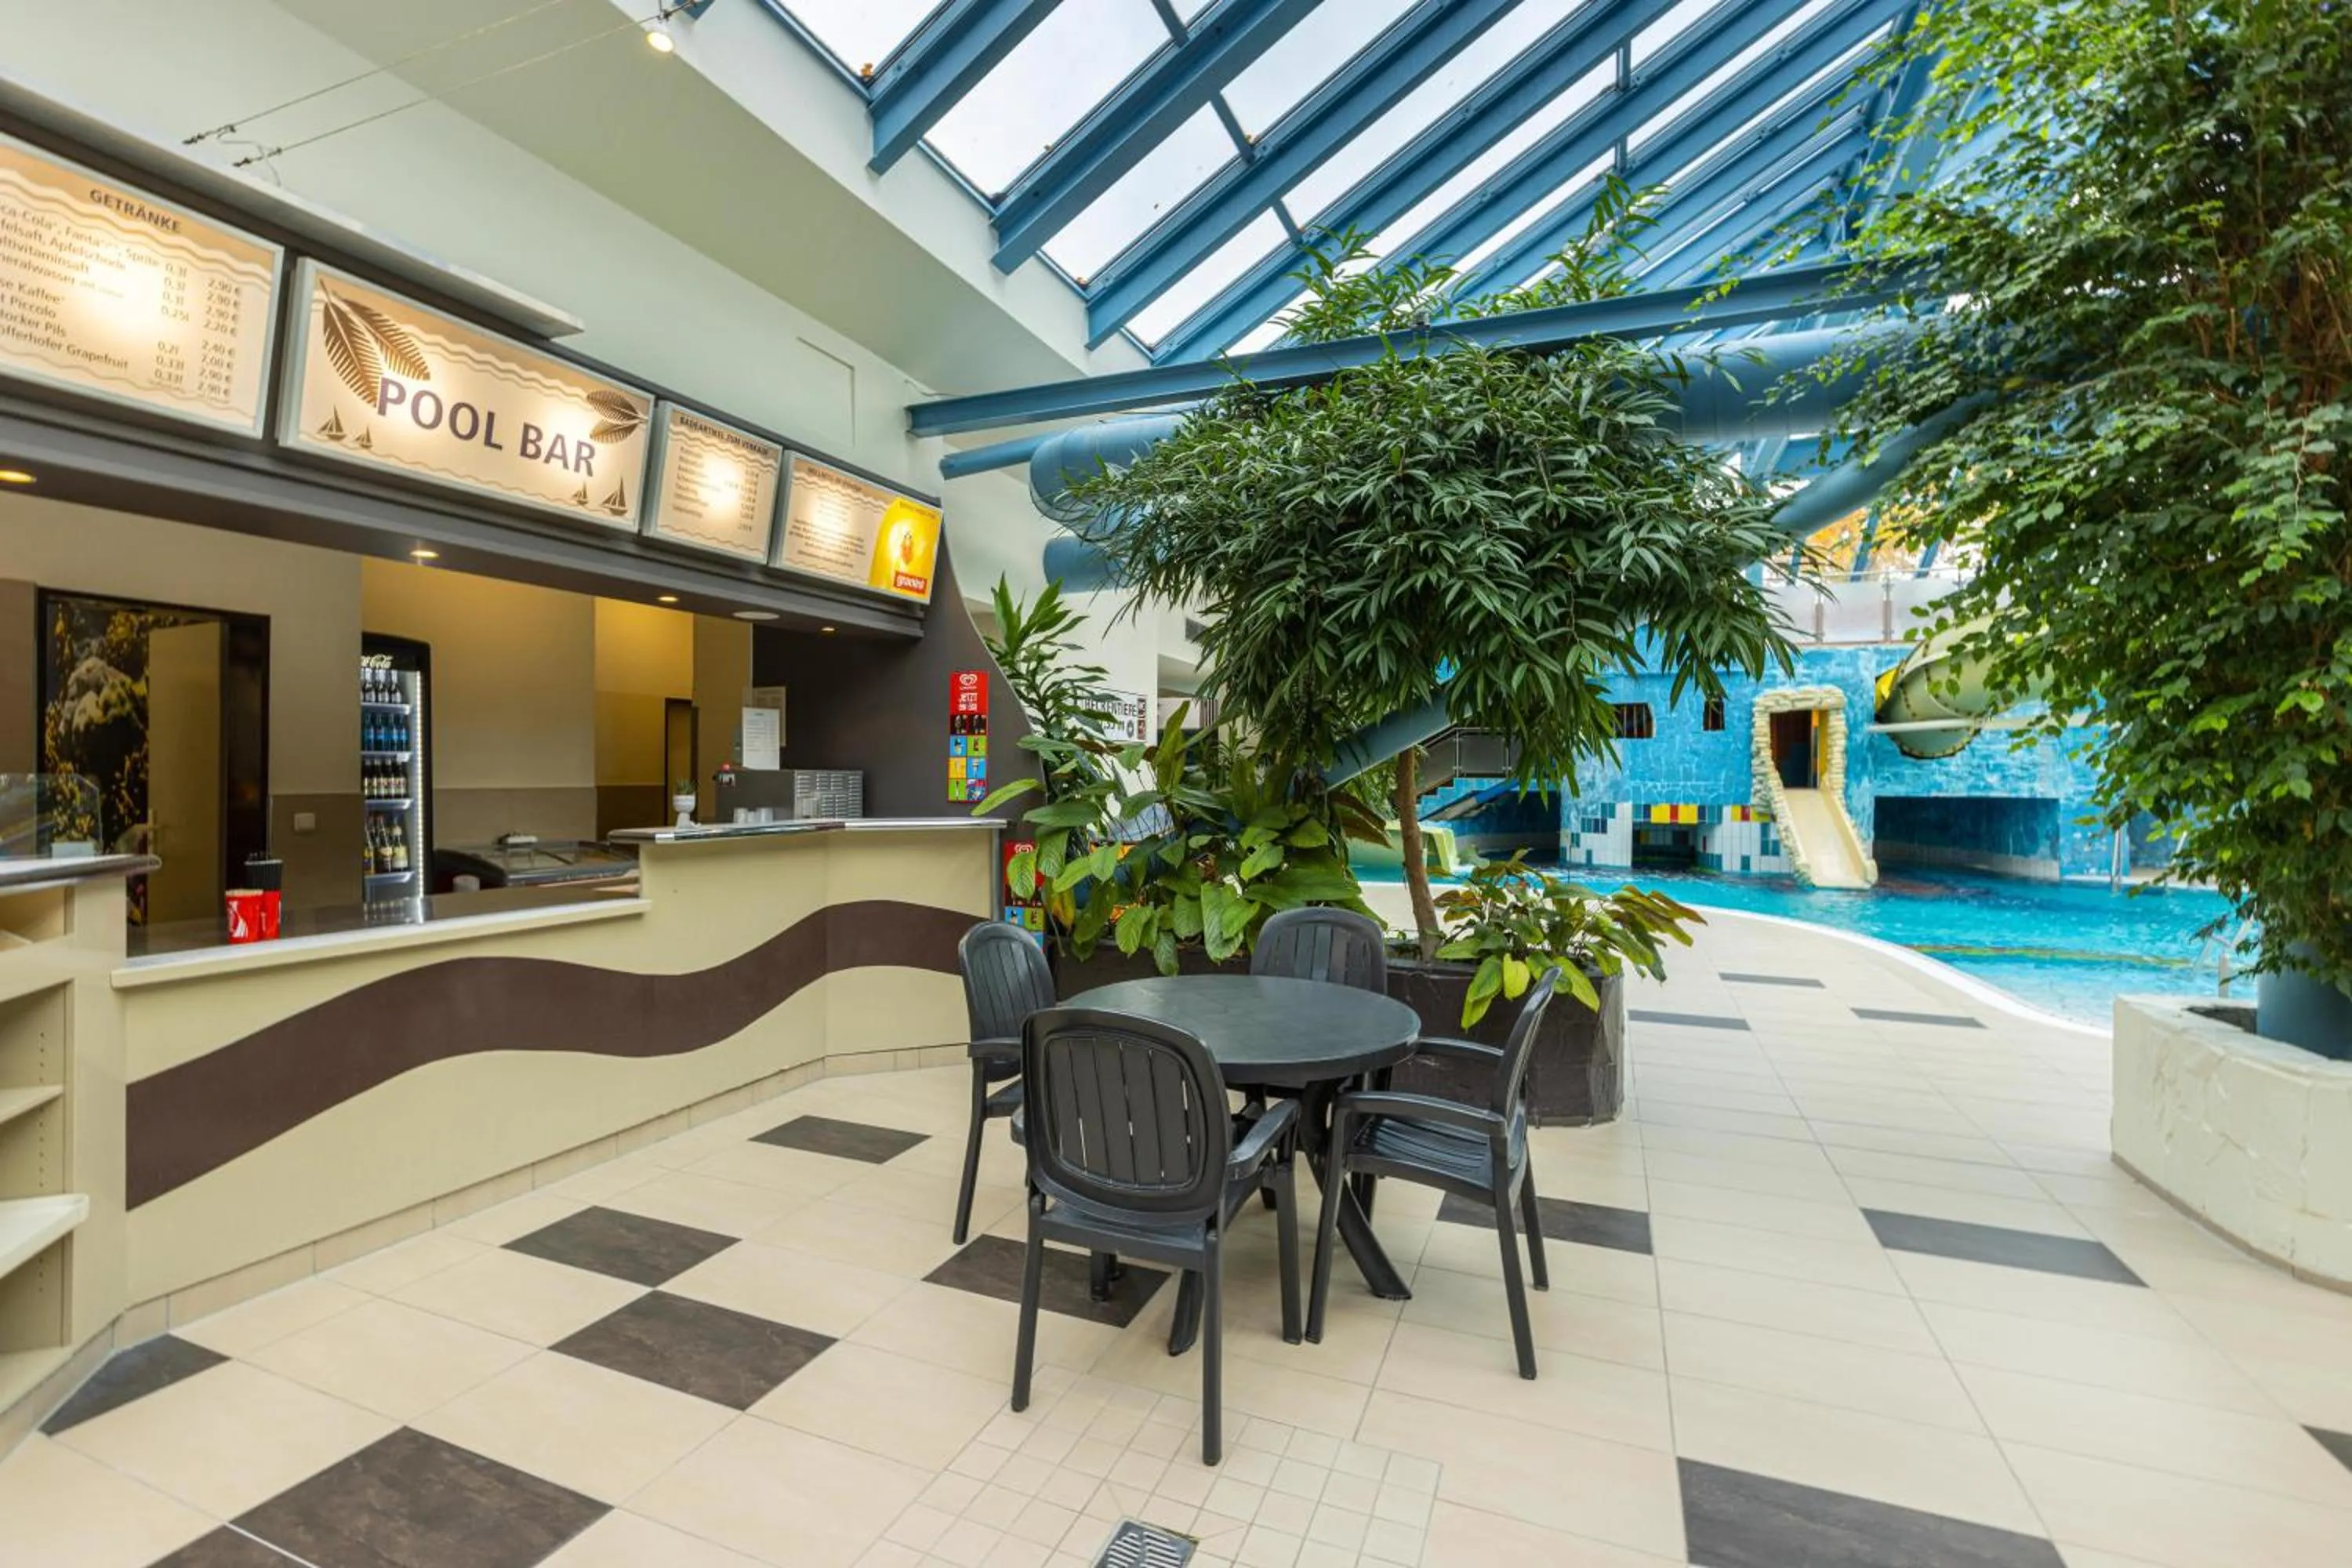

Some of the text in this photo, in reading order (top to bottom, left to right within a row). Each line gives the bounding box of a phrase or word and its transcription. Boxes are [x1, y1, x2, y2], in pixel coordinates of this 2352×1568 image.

[89, 189, 182, 234] GETRÄNKE
[45, 320, 67, 338] Pils
[67, 343, 129, 369] Grapefruit
[376, 376, 596, 477] POOL BAR
